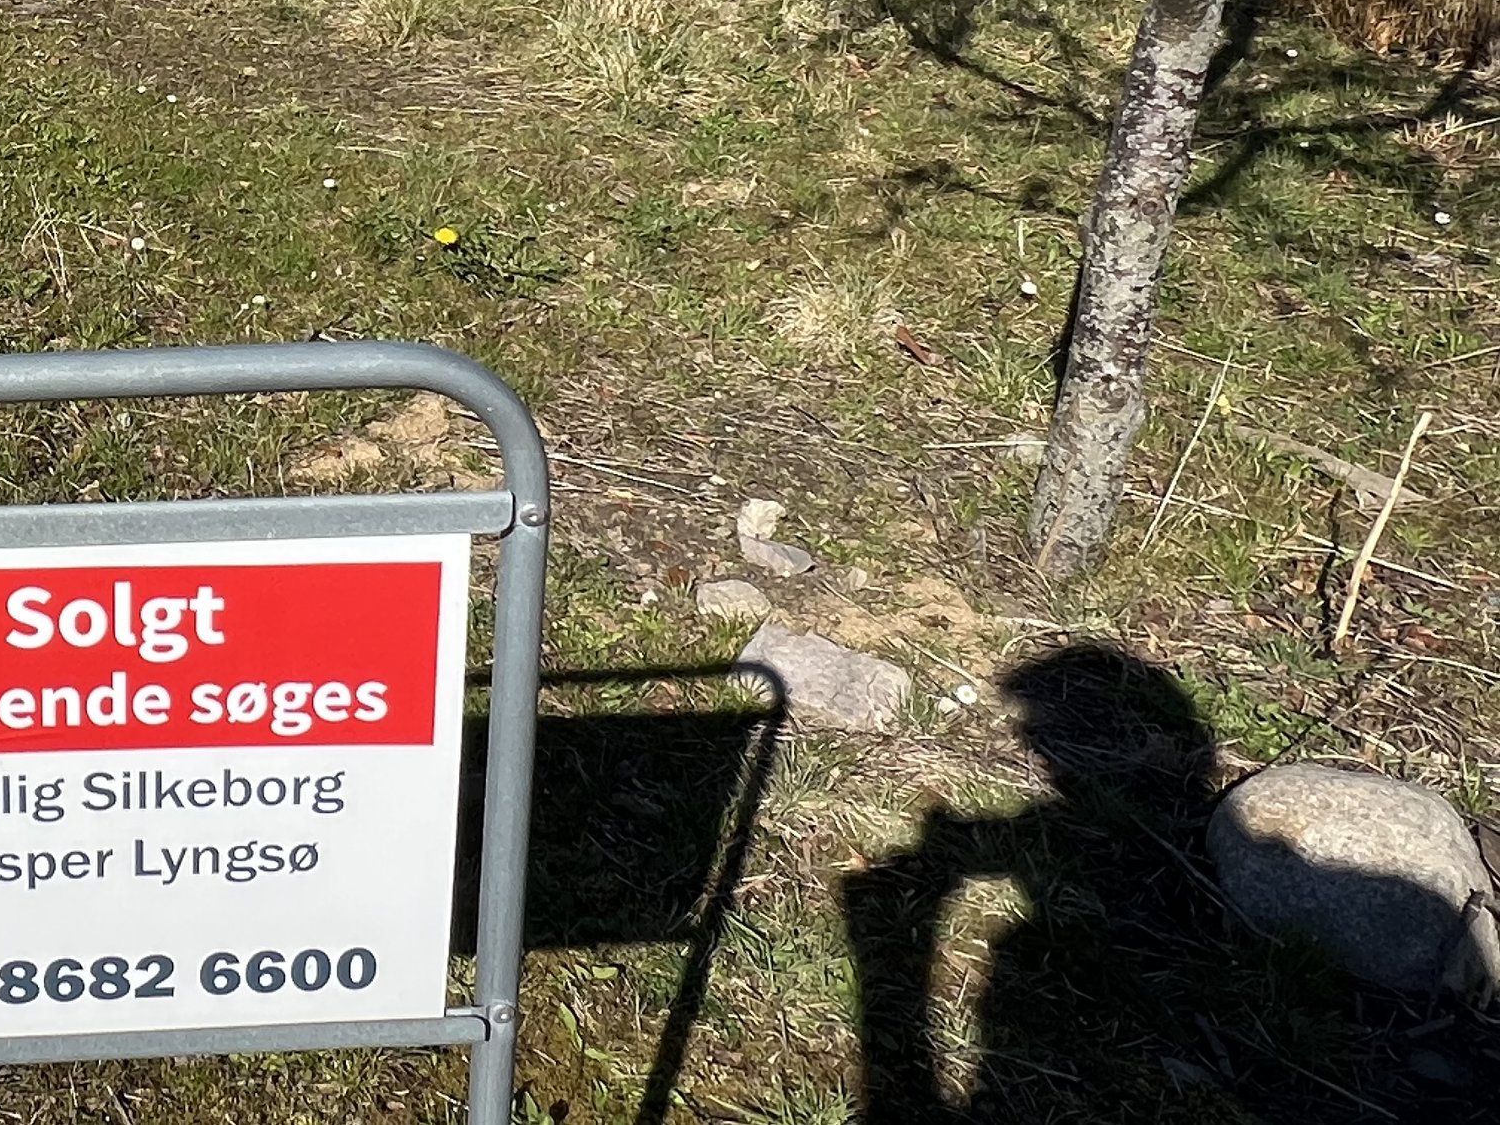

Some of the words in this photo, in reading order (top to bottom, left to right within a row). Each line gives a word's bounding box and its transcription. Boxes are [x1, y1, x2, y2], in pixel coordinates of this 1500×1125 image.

[4, 580, 226, 663] Solgt
[189, 676, 389, 736] søges
[81, 768, 346, 814] Silkeborg
[133, 837, 320, 885] Lyngsø
[199, 947, 378, 997] 6600
